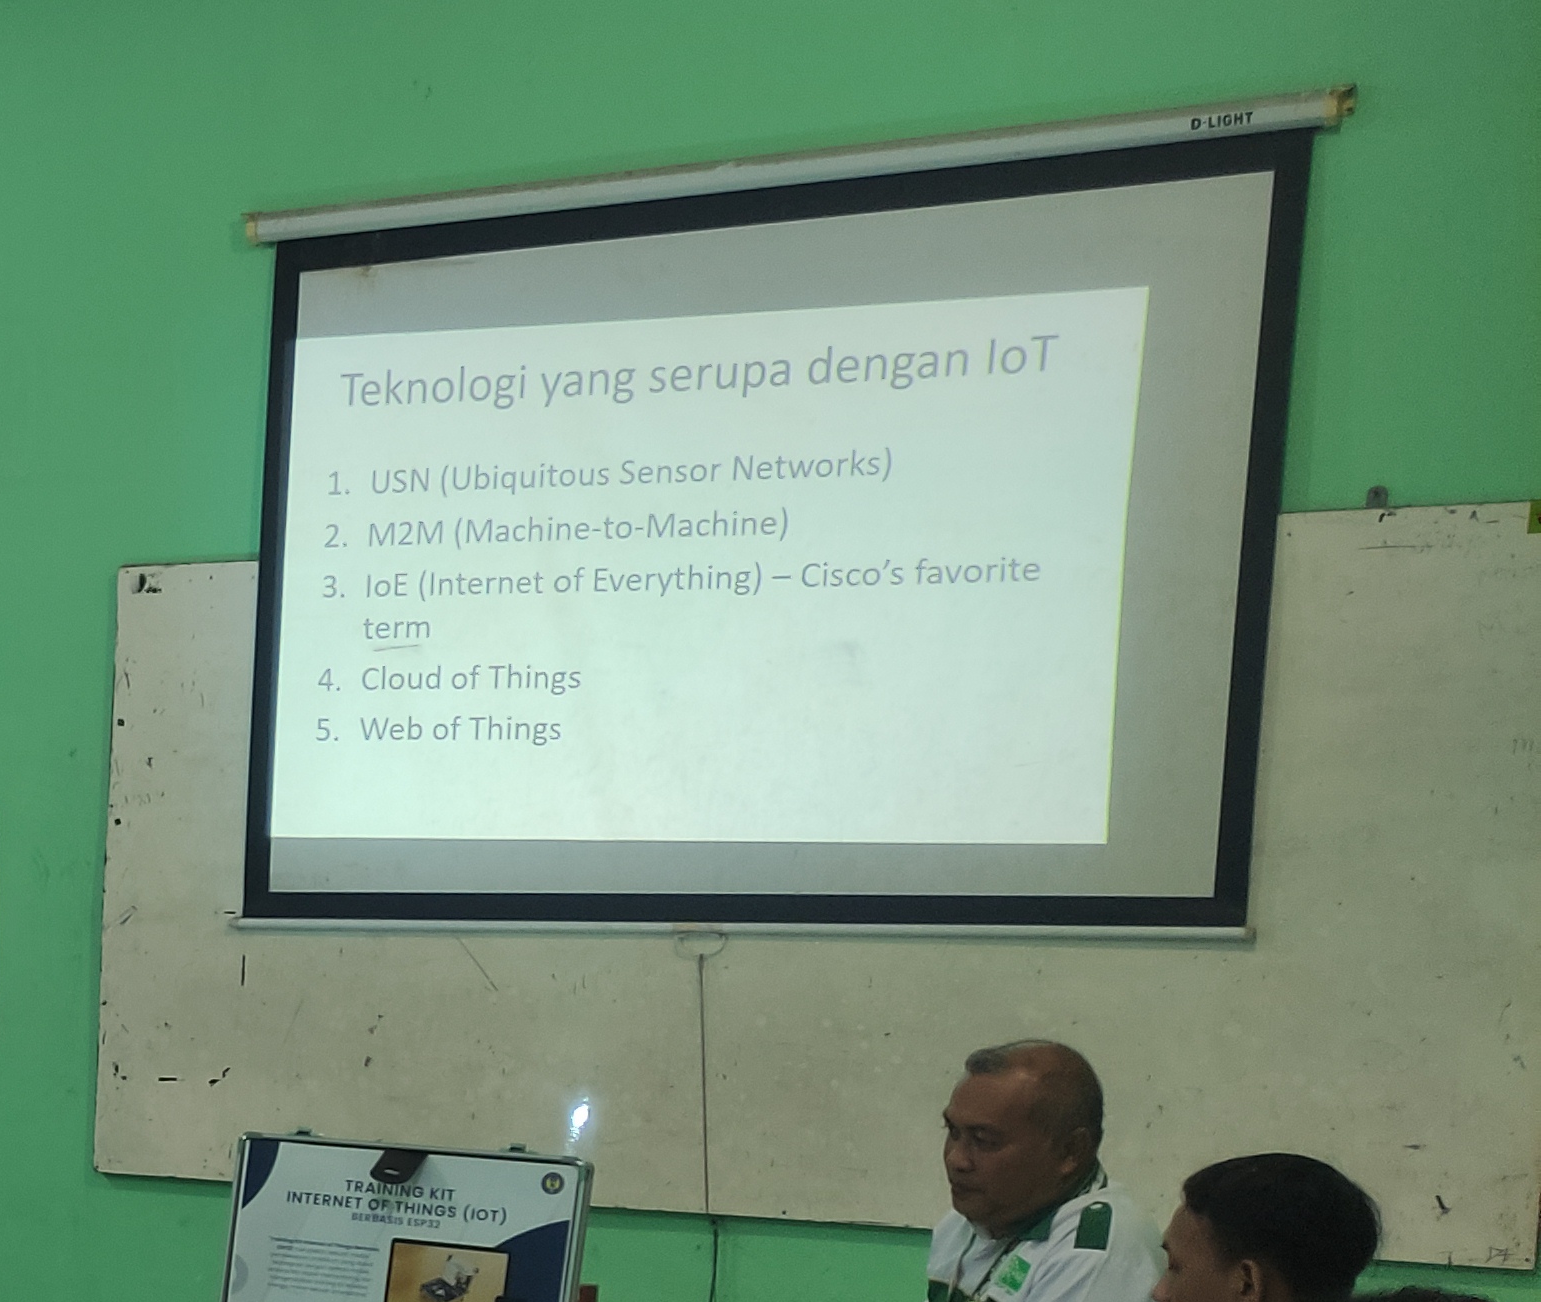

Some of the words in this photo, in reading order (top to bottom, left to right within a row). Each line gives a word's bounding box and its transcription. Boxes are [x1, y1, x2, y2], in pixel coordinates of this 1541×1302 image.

[1190, 111, 1254, 131] D-LIGHT
[340, 364, 527, 410] Teknologi
[540, 367, 636, 408] yang
[648, 359, 791, 399] serupa
[807, 345, 969, 391] dengan
[987, 334, 1059, 375] IoT
[328, 470, 350, 496] 1.
[371, 467, 430, 495] USN
[440, 462, 610, 498] (Ubiquitous
[619, 459, 722, 485] Sensor
[732, 447, 892, 482] Networks)
[324, 523, 348, 549] 2.
[368, 519, 444, 547] M2M
[454, 506, 789, 550] (Machine-to-Machine)
[322, 574, 346, 599] 3.
[366, 572, 409, 598] IoE
[418, 569, 544, 602] (Internet
[553, 566, 586, 594] of
[593, 561, 762, 598] Everything)
[914, 556, 1041, 585] favorite
[362, 617, 431, 640] term
[317, 667, 341, 692] 4.
[361, 664, 442, 691] Cloud
[450, 663, 482, 691] of
[487, 663, 582, 696] Things
[315, 717, 339, 742] 5.
[359, 715, 424, 742] Web
[432, 715, 462, 741] of
[468, 714, 562, 747] Things
[345, 1179, 424, 1198] TRAINING
[430, 1187, 456, 1201] KIT
[286, 1190, 362, 1210] INTERNET
[368, 1198, 389, 1211] OF
[395, 1201, 457, 1218] THINGS
[463, 1204, 507, 1226] (IOT)
[351, 1212, 403, 1226] BERBASIS
